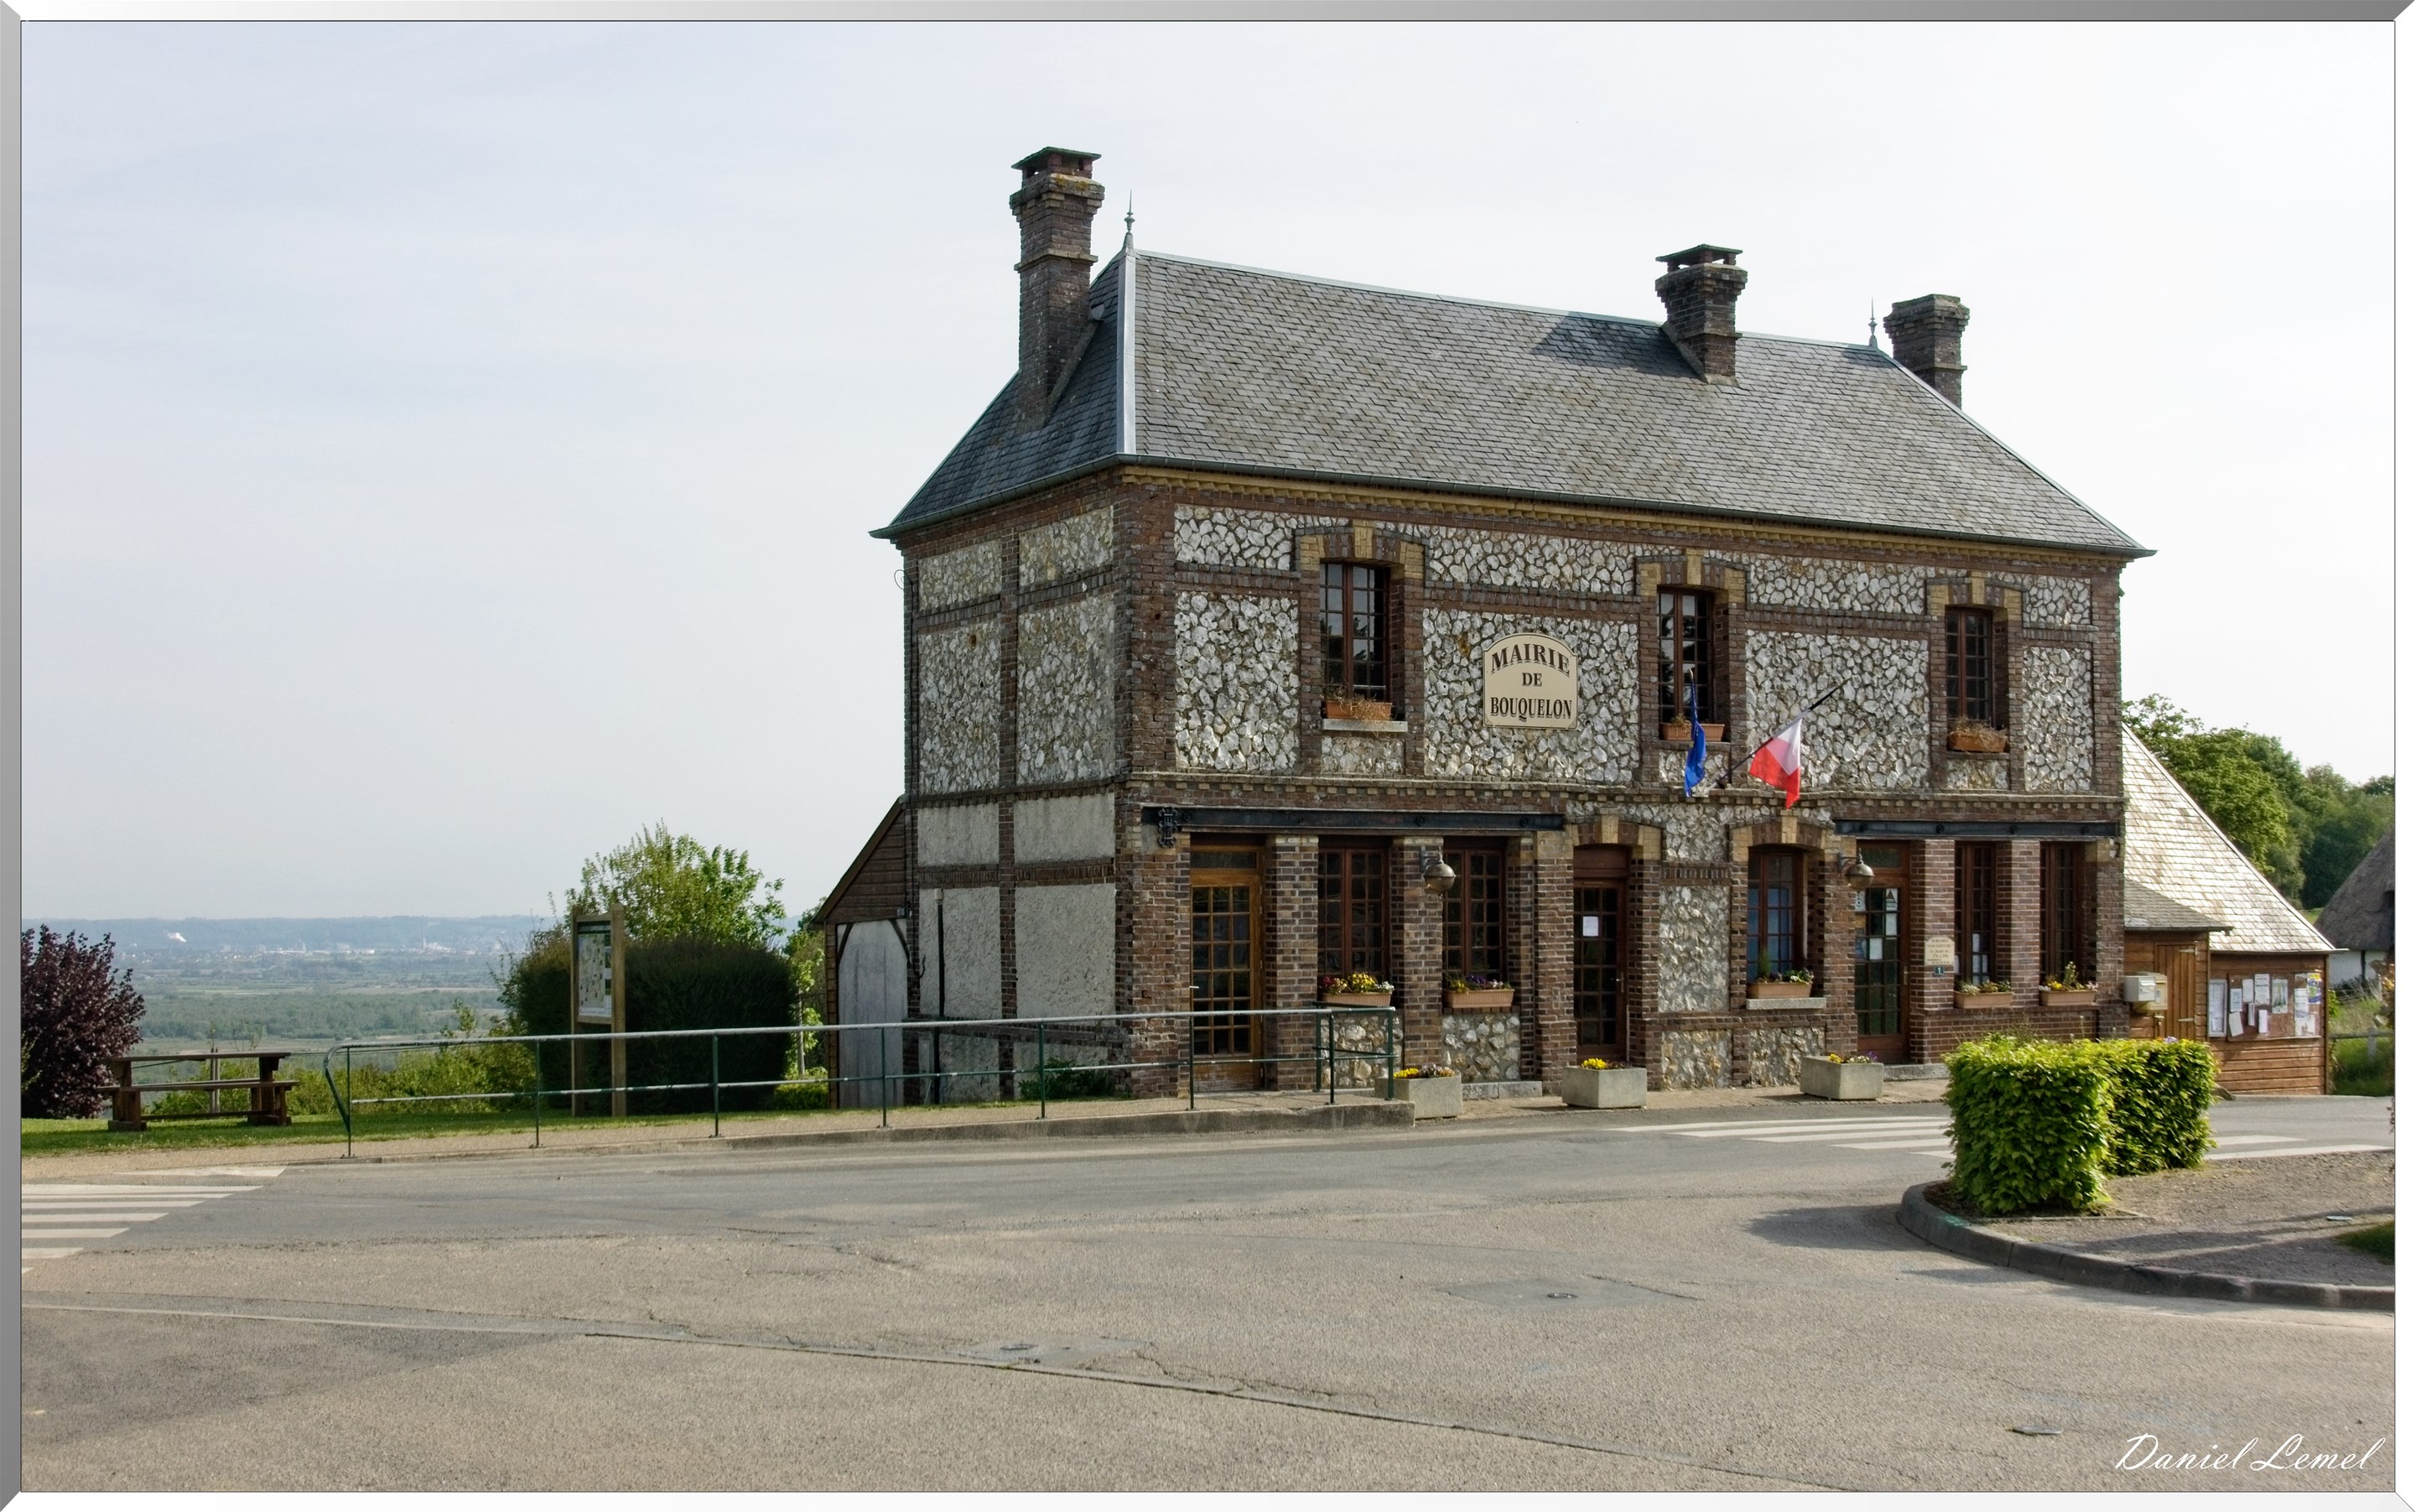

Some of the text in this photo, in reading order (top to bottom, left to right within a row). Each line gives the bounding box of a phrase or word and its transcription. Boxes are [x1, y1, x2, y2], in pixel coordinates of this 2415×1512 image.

[1491, 643, 1570, 677] MAIRIE
[1522, 672, 1542, 687] DE
[1490, 697, 1572, 721] BOUQUELON
